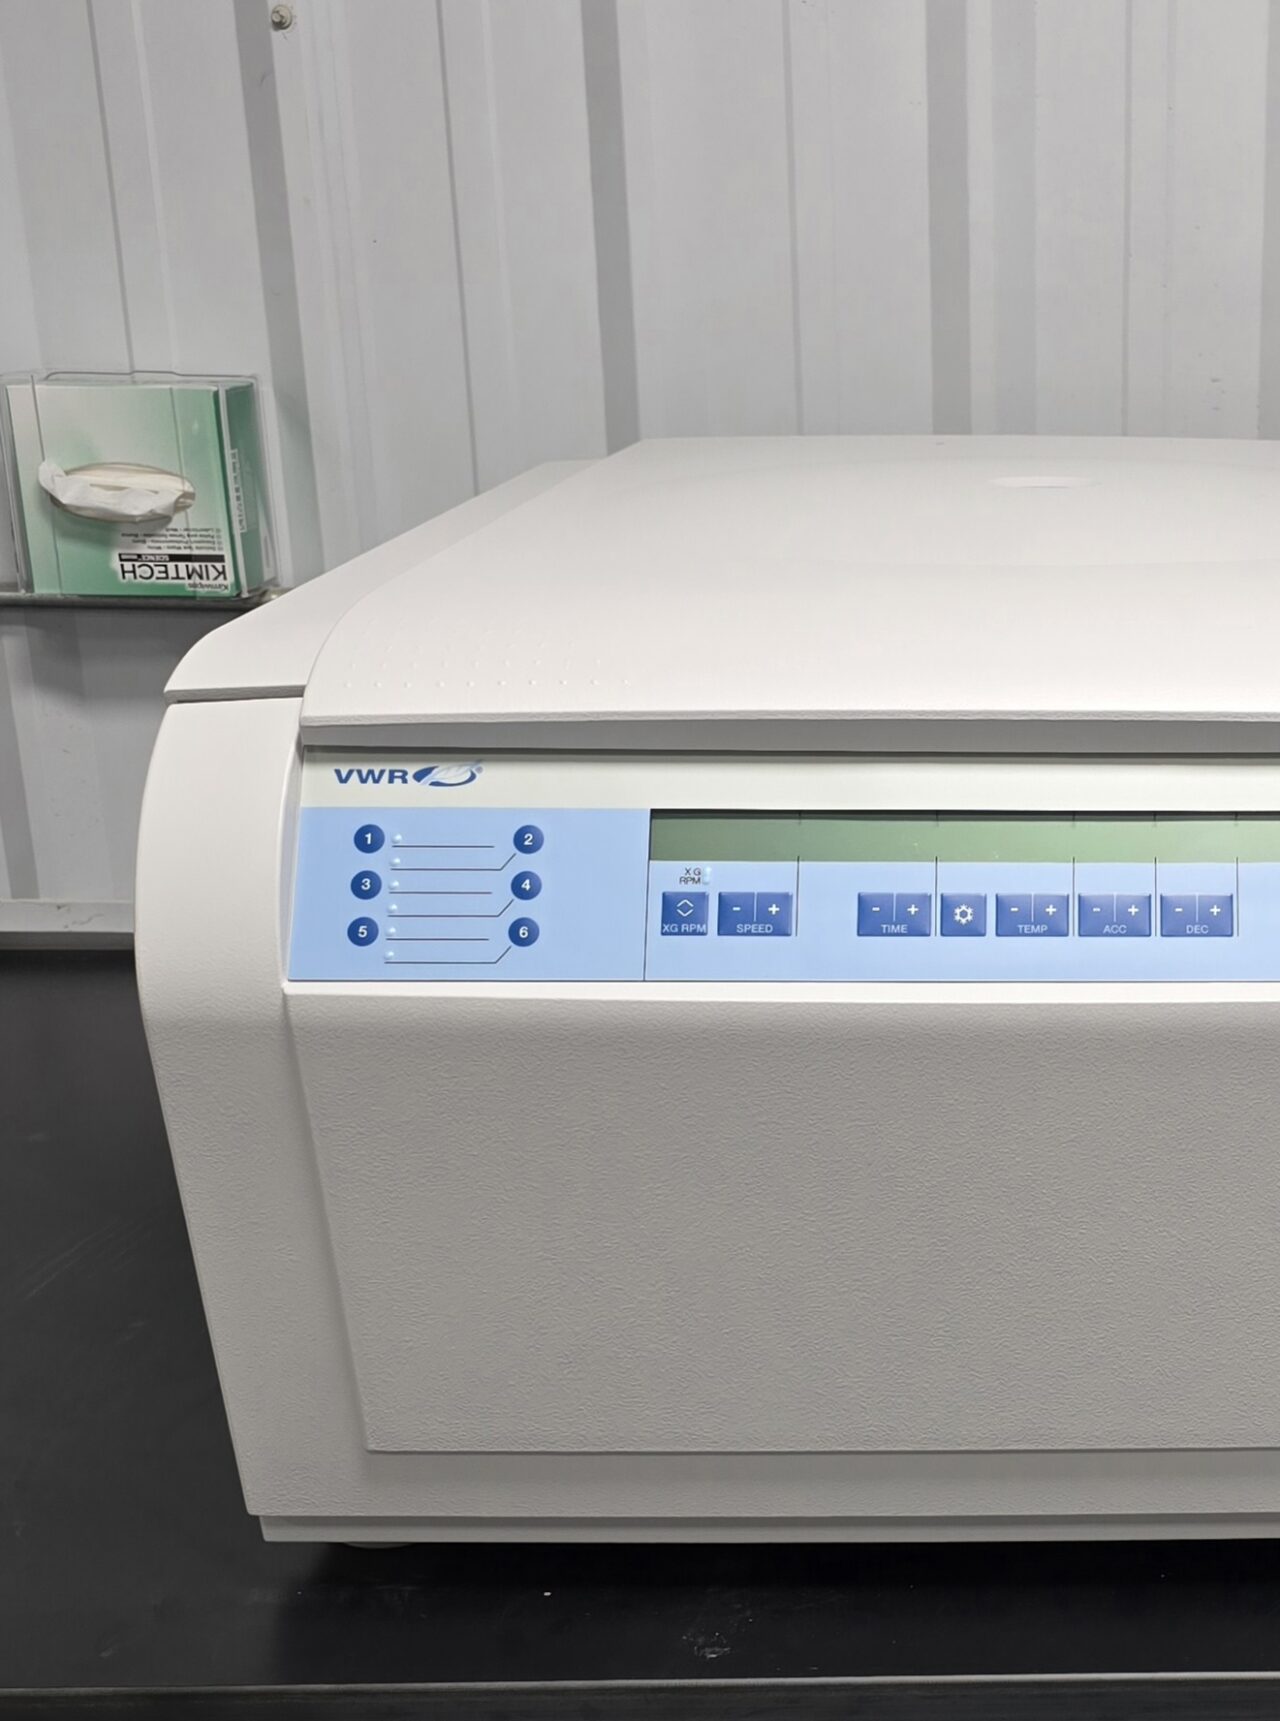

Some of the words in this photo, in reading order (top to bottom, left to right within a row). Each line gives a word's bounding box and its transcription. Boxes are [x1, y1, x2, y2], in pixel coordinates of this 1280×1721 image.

[120, 563, 227, 581] KIMTECH
[333, 768, 409, 784] VWR
[364, 833, 373, 845] 1
[523, 833, 534, 845] 2
[360, 879, 371, 890] 3
[521, 879, 531, 891] 4
[679, 877, 701, 885] RPM
[357, 926, 368, 938] 5
[518, 926, 529, 938] 6
[662, 924, 679, 933] XG
[681, 924, 707, 933] RPM
[736, 924, 774, 934] SPEED
[880, 924, 908, 934] TIME
[1017, 924, 1048, 934] TEMP
[1103, 924, 1127, 934] ACC
[1186, 924, 1209, 934] DEC
